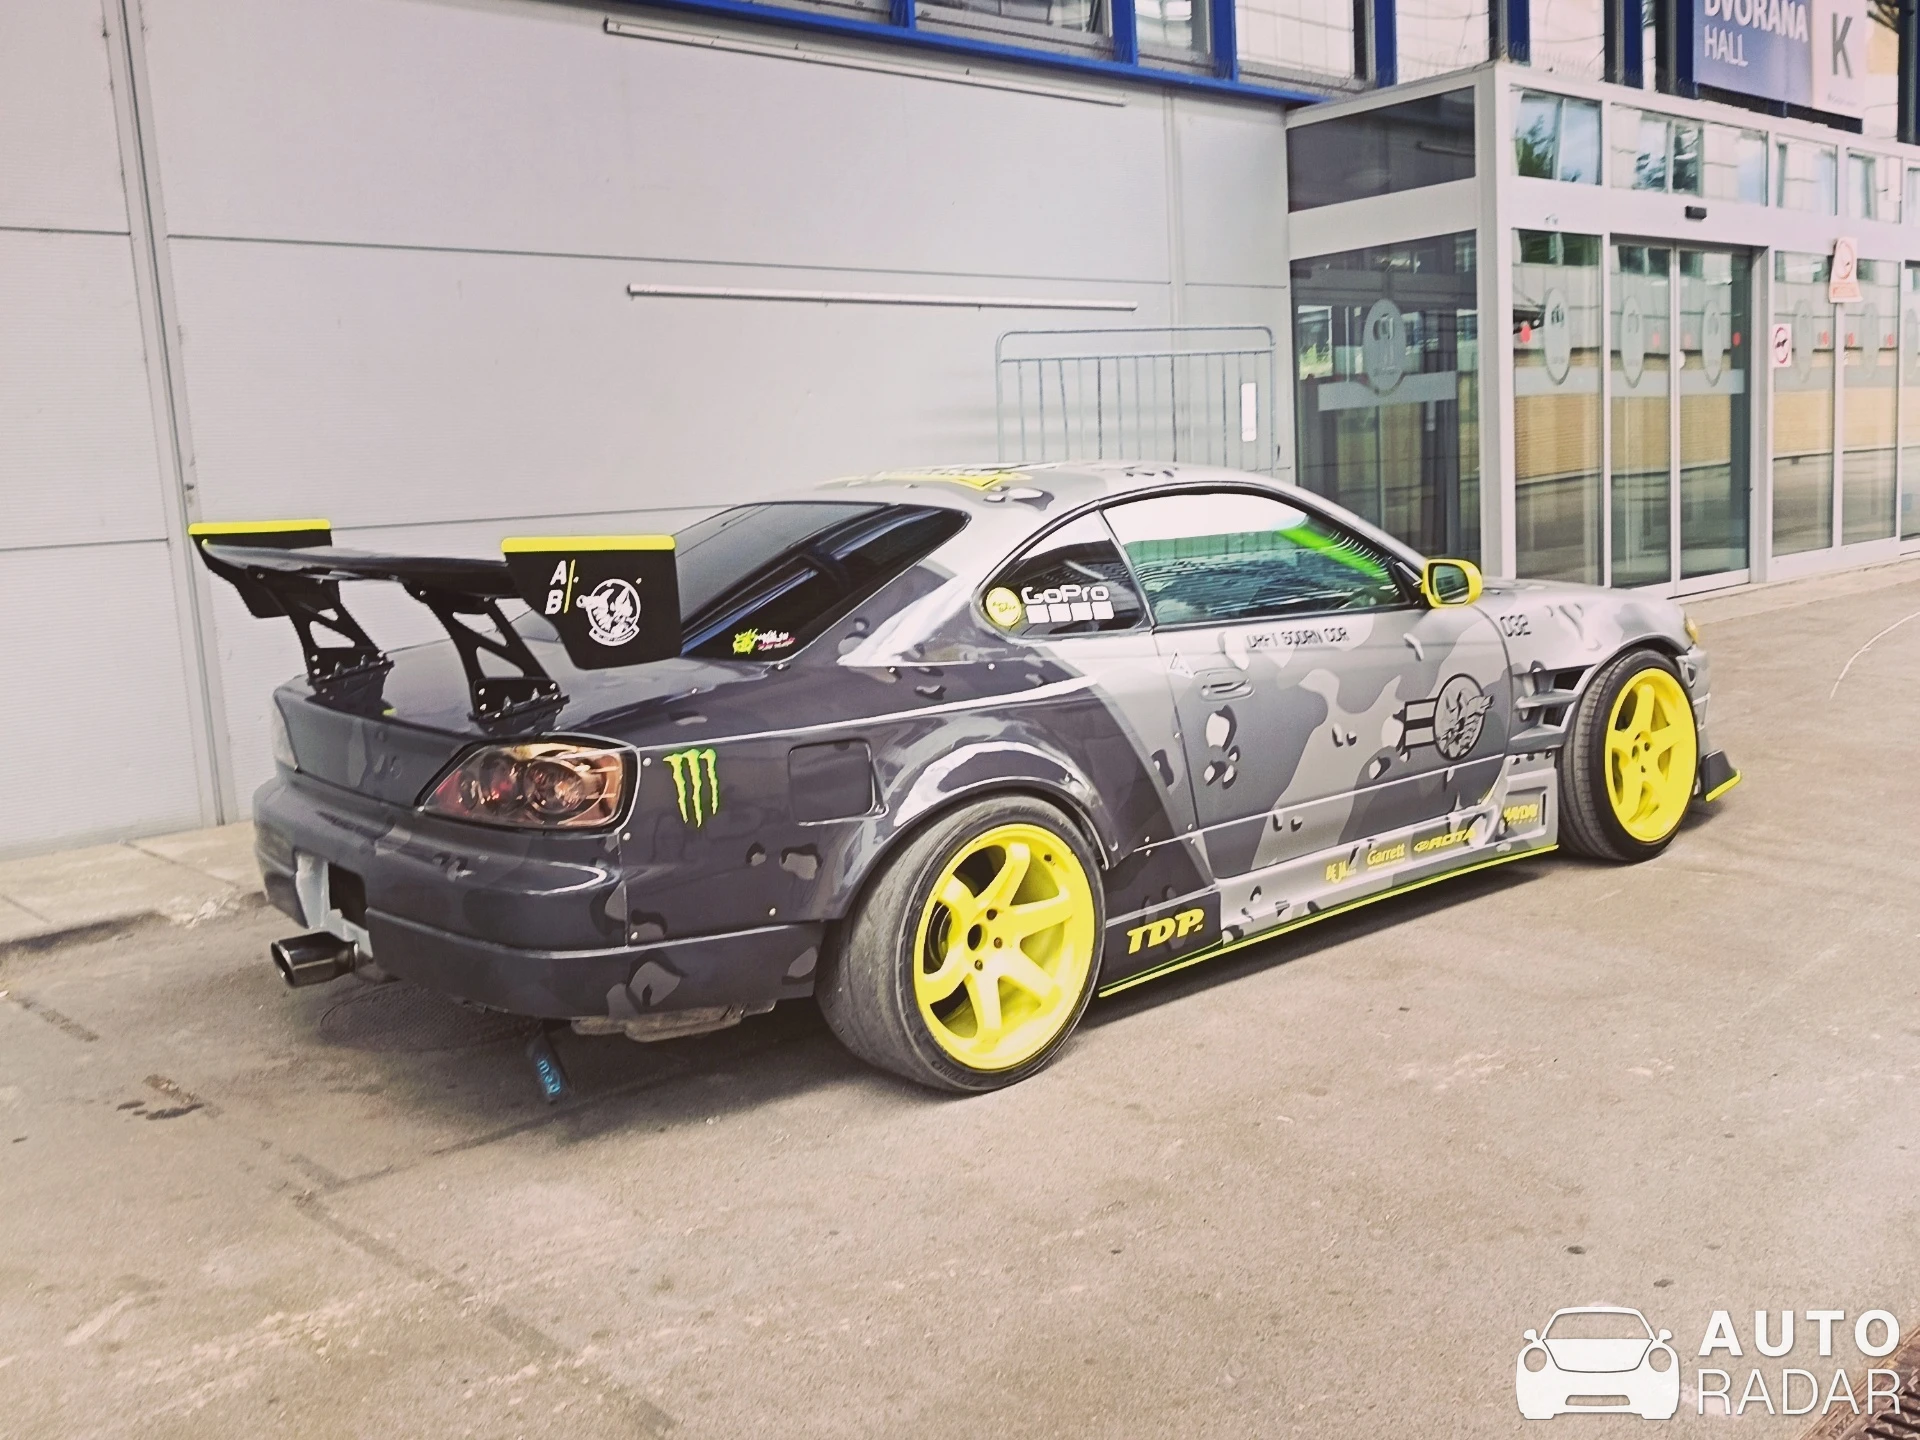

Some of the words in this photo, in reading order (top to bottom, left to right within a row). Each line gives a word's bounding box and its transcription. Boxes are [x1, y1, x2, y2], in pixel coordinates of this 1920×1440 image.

[1704, 24, 1748, 67] HALL
[1832, 12, 1853, 79] K
[1021, 584, 1110, 605] GoPro
[1366, 843, 1406, 866] Garrett
